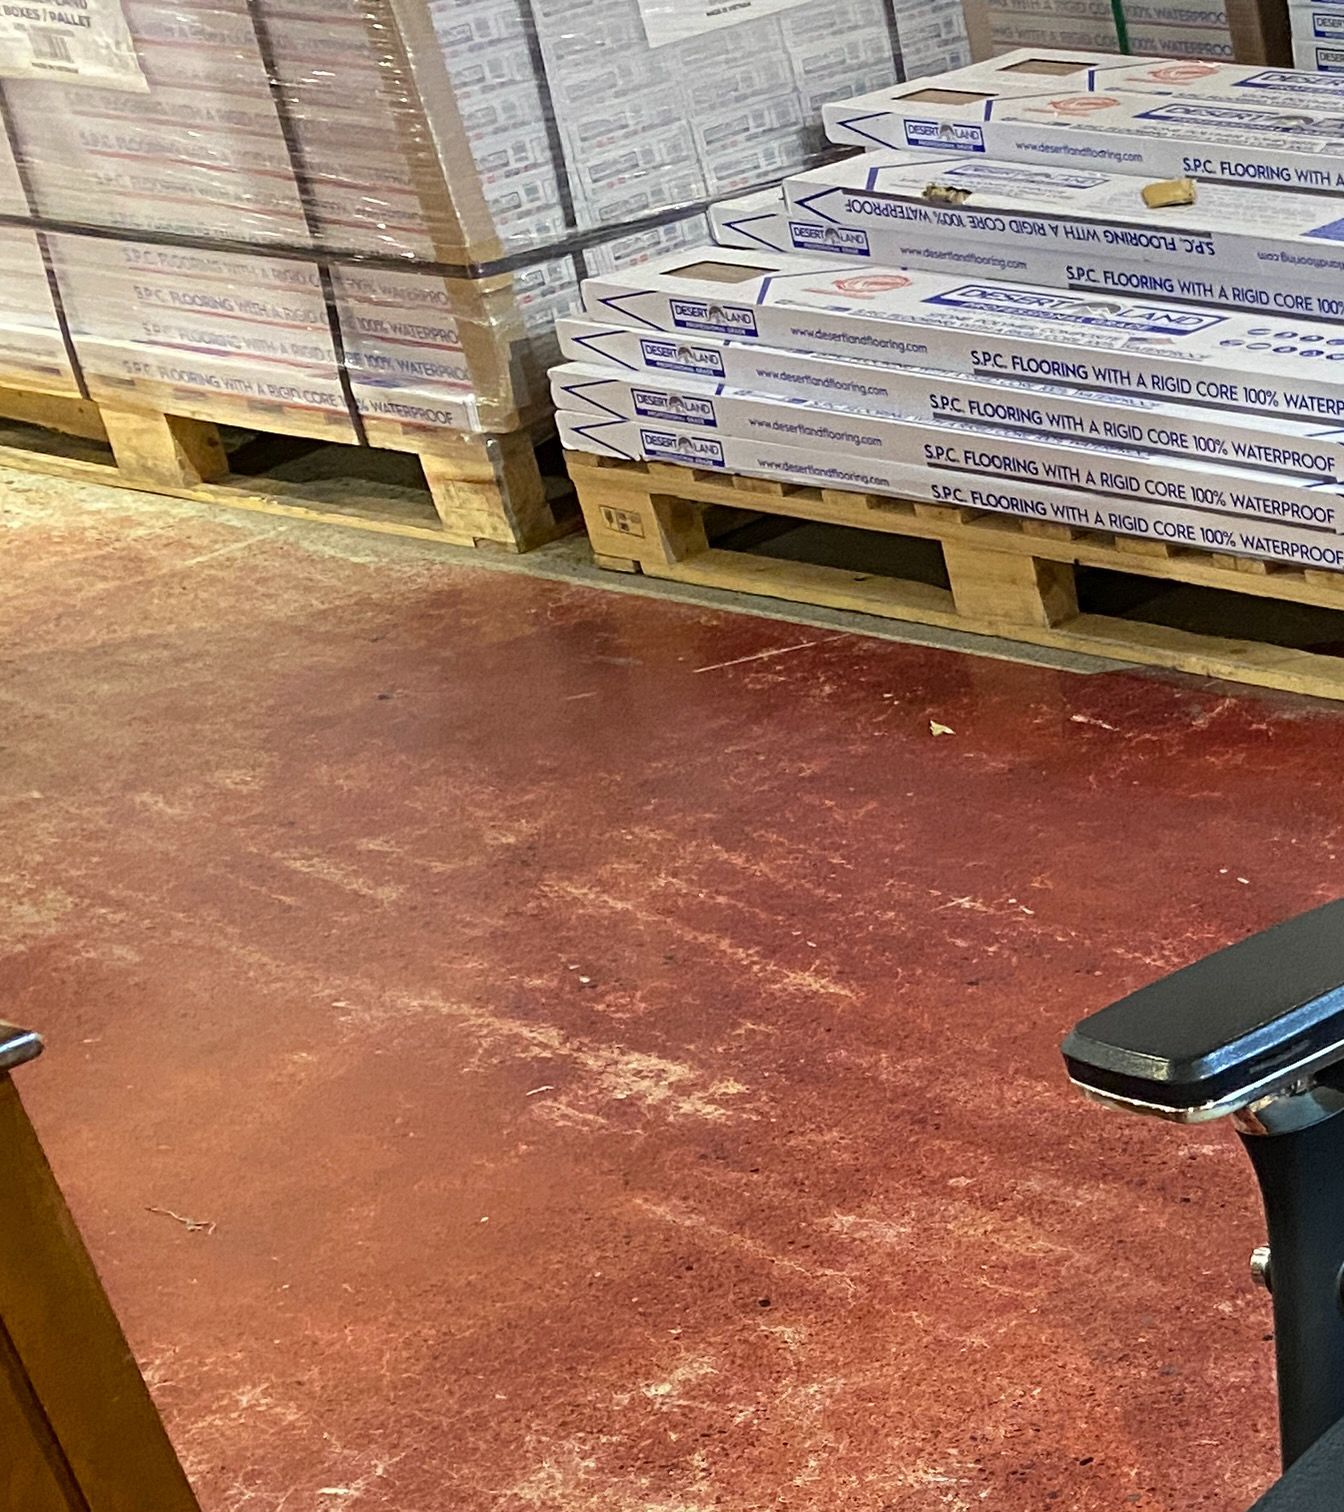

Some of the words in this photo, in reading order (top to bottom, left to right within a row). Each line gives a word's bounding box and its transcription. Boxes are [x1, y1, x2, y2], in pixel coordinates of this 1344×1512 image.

[48, 11, 91, 28] PALLET
[1155, 8, 1226, 24] WATERPROO
[1161, 39, 1232, 56] WATERPROO
[908, 125, 939, 137] DESERT
[955, 128, 979, 140] LAND
[1183, 157, 1216, 174] S.P.C.
[1220, 161, 1290, 181] FLOORING
[1295, 169, 1330, 186] WITH
[1336, 176, 1344, 187] A
[845, 199, 930, 223] WATERPROOF
[932, 211, 965, 227] 100%
[968, 216, 1006, 232] CORE
[1009, 220, 1046, 236] RIGID
[1051, 224, 1060, 237] A
[1065, 225, 1100, 242] WITH
[794, 227, 825, 240] DESERT
[840, 232, 864, 245] LAND
[1104, 230, 1176, 251] FLOORING
[1180, 238, 1215, 255] S.P.C.
[1066, 265, 1099, 283] S.P.C.
[1103, 271, 1174, 292] FLOORING
[1178, 279, 1213, 297] WITH
[1218, 286, 1228, 300] A
[1233, 287, 1269, 305] RIGID
[1274, 293, 1313, 311] CORE
[675, 304, 708, 318] DESERT
[726, 311, 751, 324] LAND
[957, 289, 1073, 308] DESERT
[1118, 309, 1204, 325] LAND
[392, 324, 458, 344] WATERPRO
[790, 326, 927, 354] www.desertlandflooring.com
[646, 344, 677, 358] DESERT
[694, 352, 718, 365] LAND
[397, 360, 470, 382] WATERPROO
[971, 350, 1007, 369] S.P.C.
[1012, 356, 1088, 380] FLOORING
[1092, 366, 1131, 386] WITH
[1136, 373, 1147, 389] A
[1151, 374, 1191, 394] RIGID
[1196, 381, 1239, 401] CORE
[1243, 387, 1278, 408] 100%
[755, 368, 888, 397] www.desertlandflooring.com
[159, 366, 220, 388] FLOORING
[223, 377, 252, 393] WITH
[269, 384, 301, 400] RIGID
[304, 390, 336, 407] CORE
[370, 401, 452, 425] WATERPROOF
[637, 393, 668, 407] DESERT
[685, 402, 710, 414] LAND
[748, 417, 882, 446] www.desertlandflooring.com
[930, 394, 965, 413] S.P.C.
[969, 400, 1043, 425] FLOORING
[1046, 412, 1084, 432] WITH
[1089, 420, 1099, 435] A
[1103, 421, 1143, 441] RIGID
[1147, 429, 1189, 449] CORE
[1193, 435, 1228, 455] 100%
[1232, 441, 1335, 472] WATERPROOF
[645, 434, 677, 447] DESERT
[693, 442, 718, 455] LAND
[757, 457, 890, 487] www.desertlandflooring.com
[924, 444, 960, 462] S.P.C.
[964, 450, 1039, 476] FLOORING
[1042, 462, 1080, 483] WITH
[1085, 471, 1096, 485] A
[1100, 472, 1140, 492] RIGID
[1145, 479, 1186, 500] CORE
[1191, 486, 1226, 507] 100%
[1230, 492, 1335, 524] WATERPROOF
[931, 484, 967, 503] S.P.C.
[971, 490, 1047, 516] FLOORING
[1050, 503, 1089, 523] WITH
[1094, 511, 1105, 526] A
[1109, 513, 1149, 533] RIGID
[1153, 520, 1196, 541] CORE
[1200, 527, 1236, 547] 100%
[1240, 533, 1344, 565] WATERPROOF
